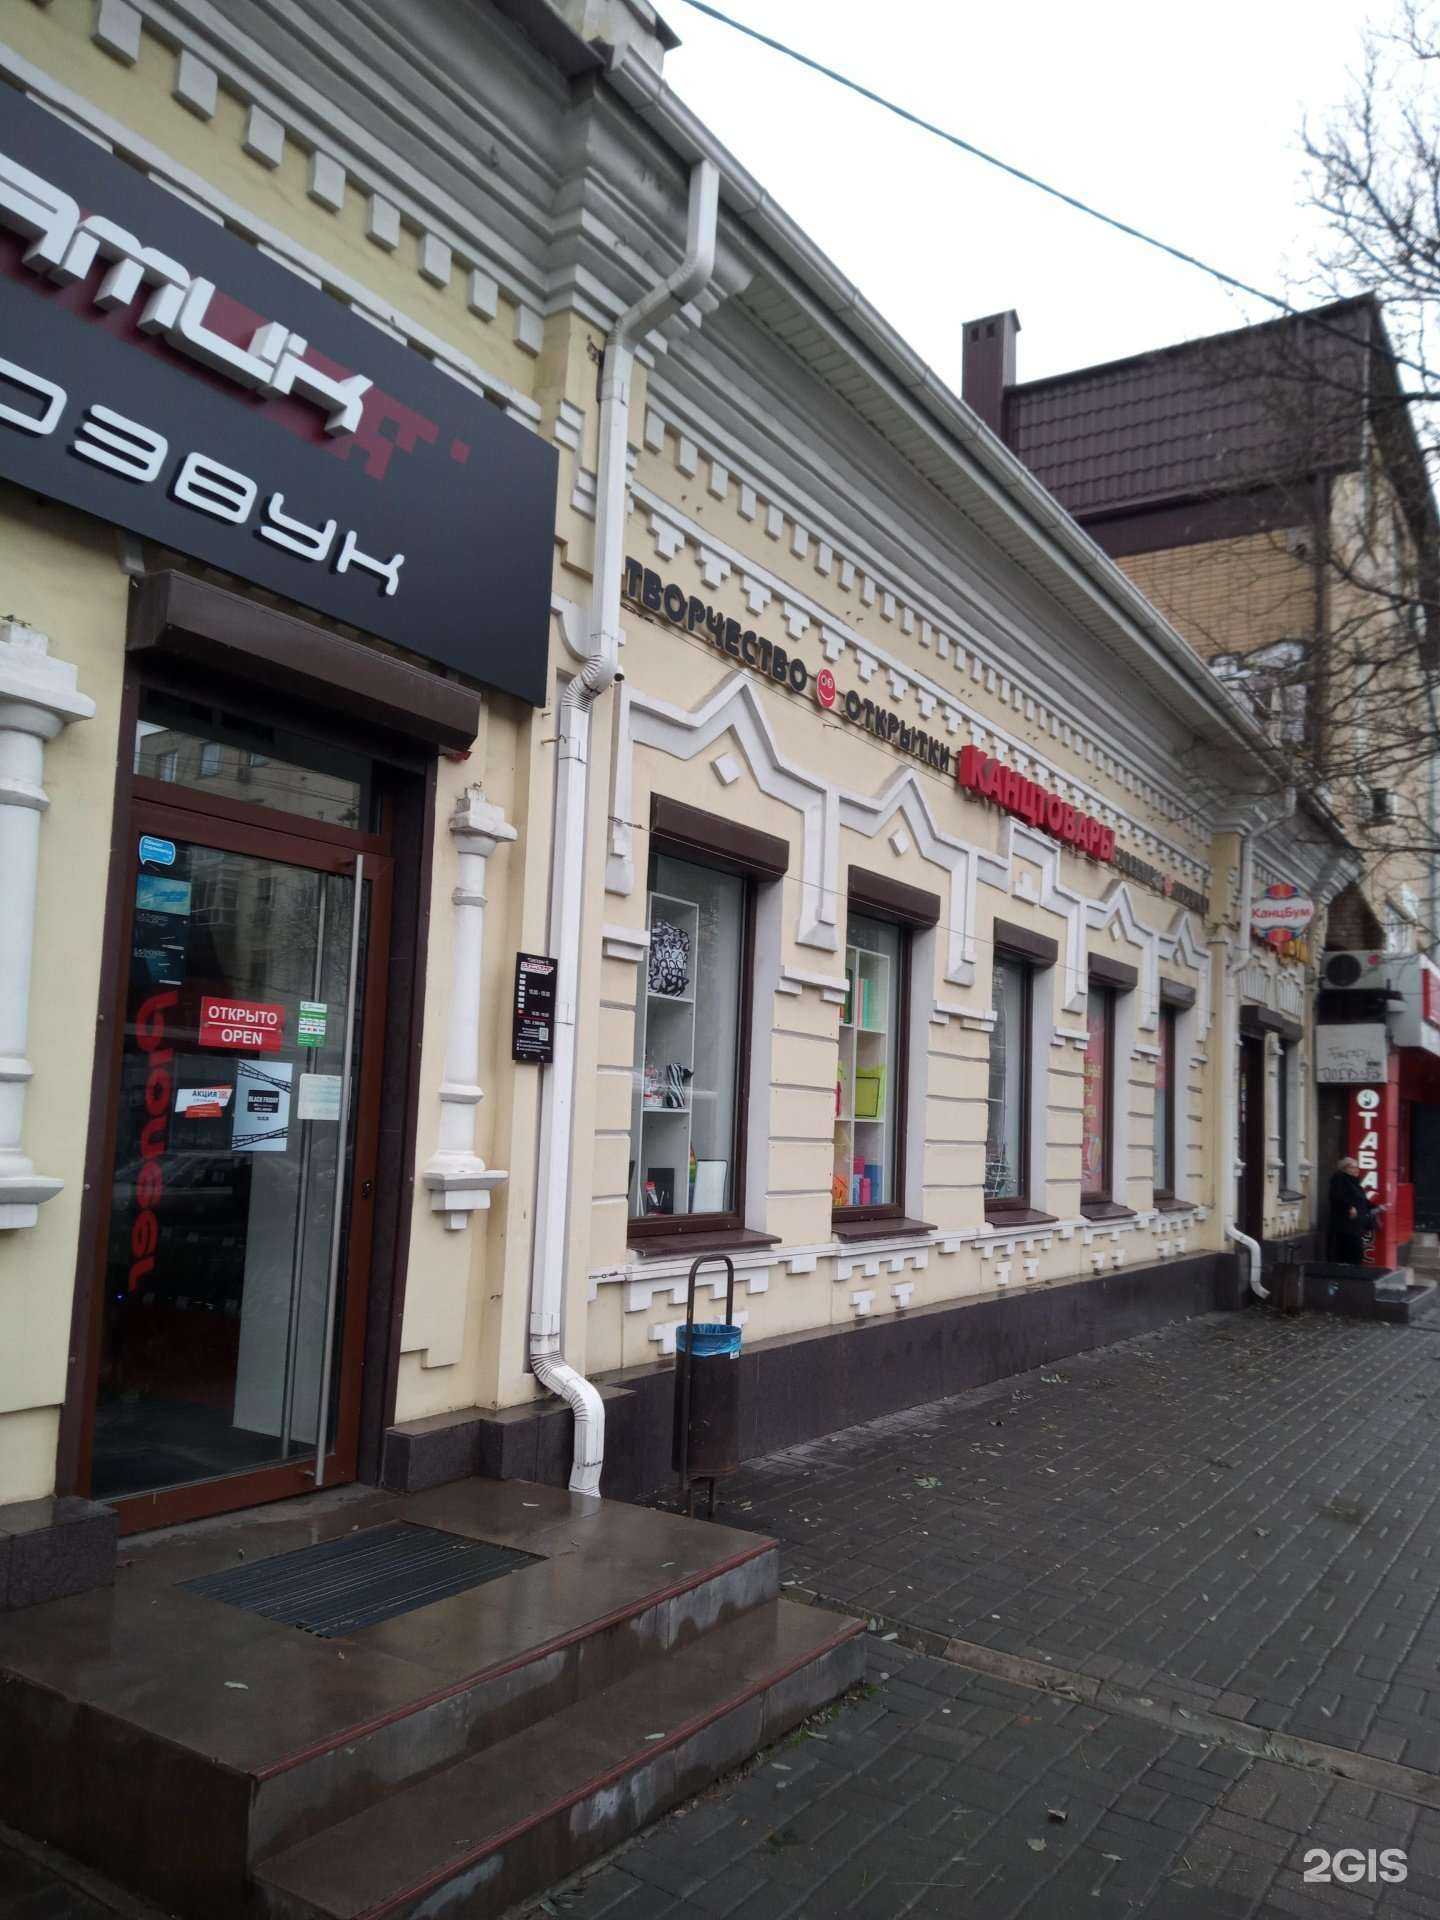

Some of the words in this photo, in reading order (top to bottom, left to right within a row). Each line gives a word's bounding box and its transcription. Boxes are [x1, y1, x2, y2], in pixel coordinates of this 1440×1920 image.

[624, 555, 807, 692] ТВОРЧЕСТВО
[844, 689, 951, 772] ОТКРЫТКИ
[958, 744, 1115, 863] КАНЦТОВАРЫ
[1251, 906, 1311, 919] КанцБум
[208, 1005, 278, 1025] ОТКРЫТО
[221, 1029, 263, 1045] OPEN
